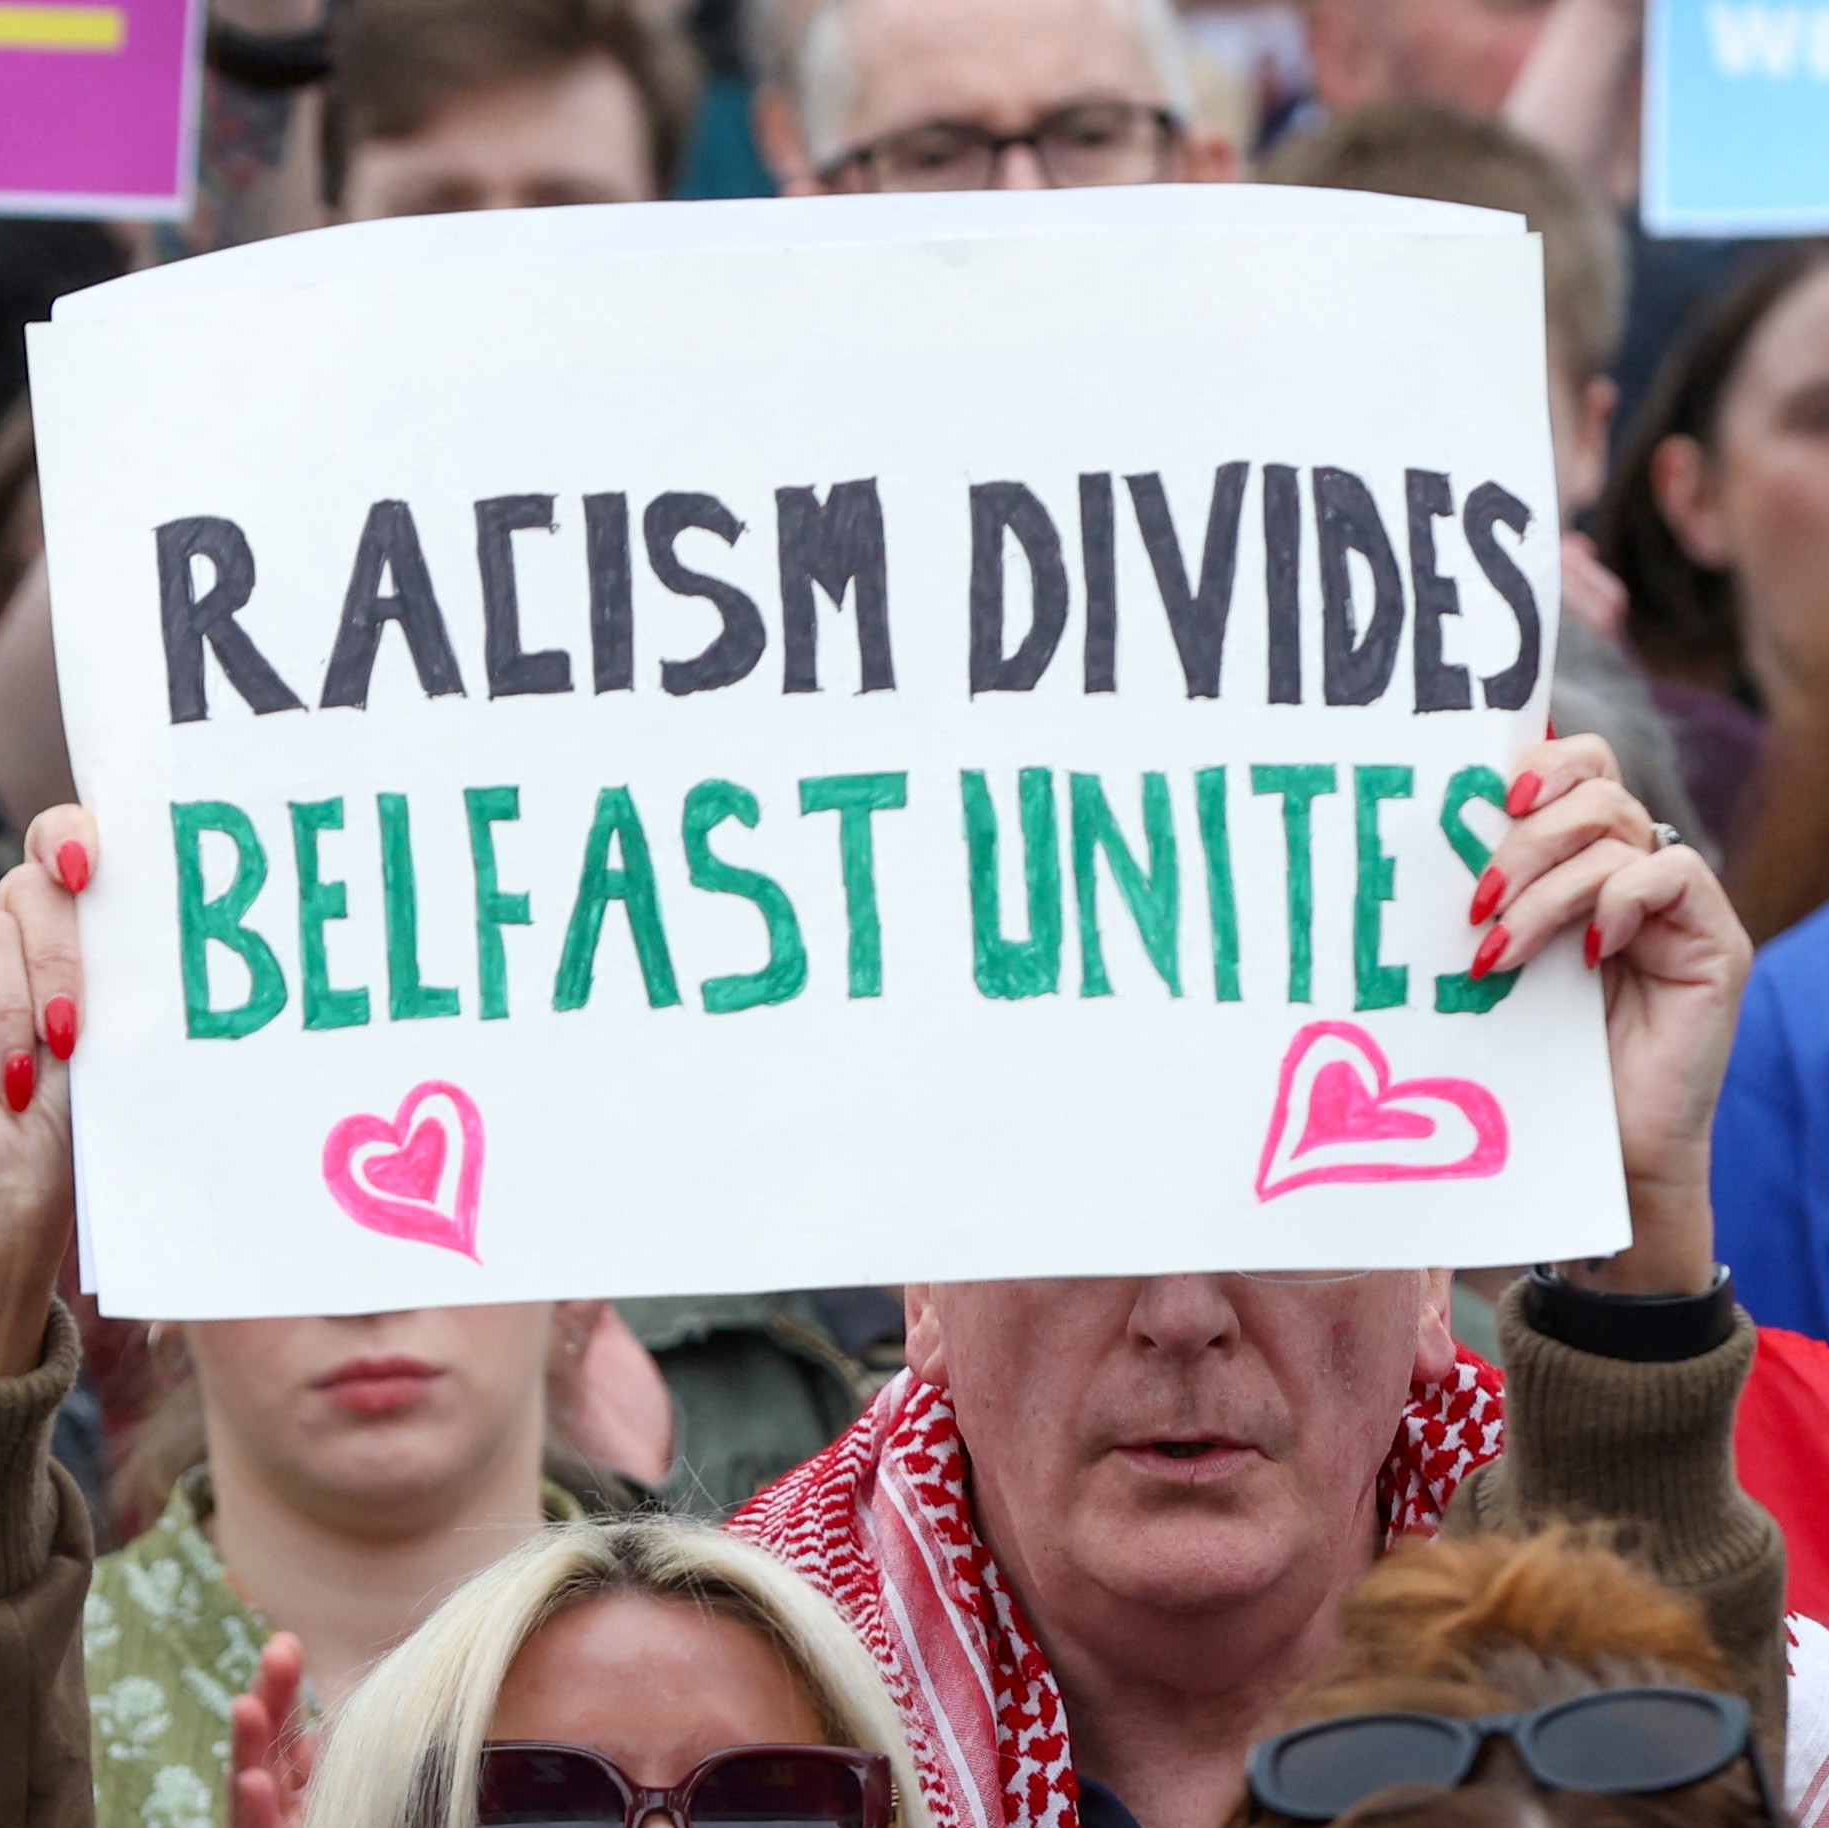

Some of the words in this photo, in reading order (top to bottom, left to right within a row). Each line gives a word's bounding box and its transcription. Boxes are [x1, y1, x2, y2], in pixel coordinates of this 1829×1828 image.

[155, 476, 897, 726] RACISM
[968, 460, 1543, 715] DIVIDES
[170, 770, 909, 1041] BELFAST
